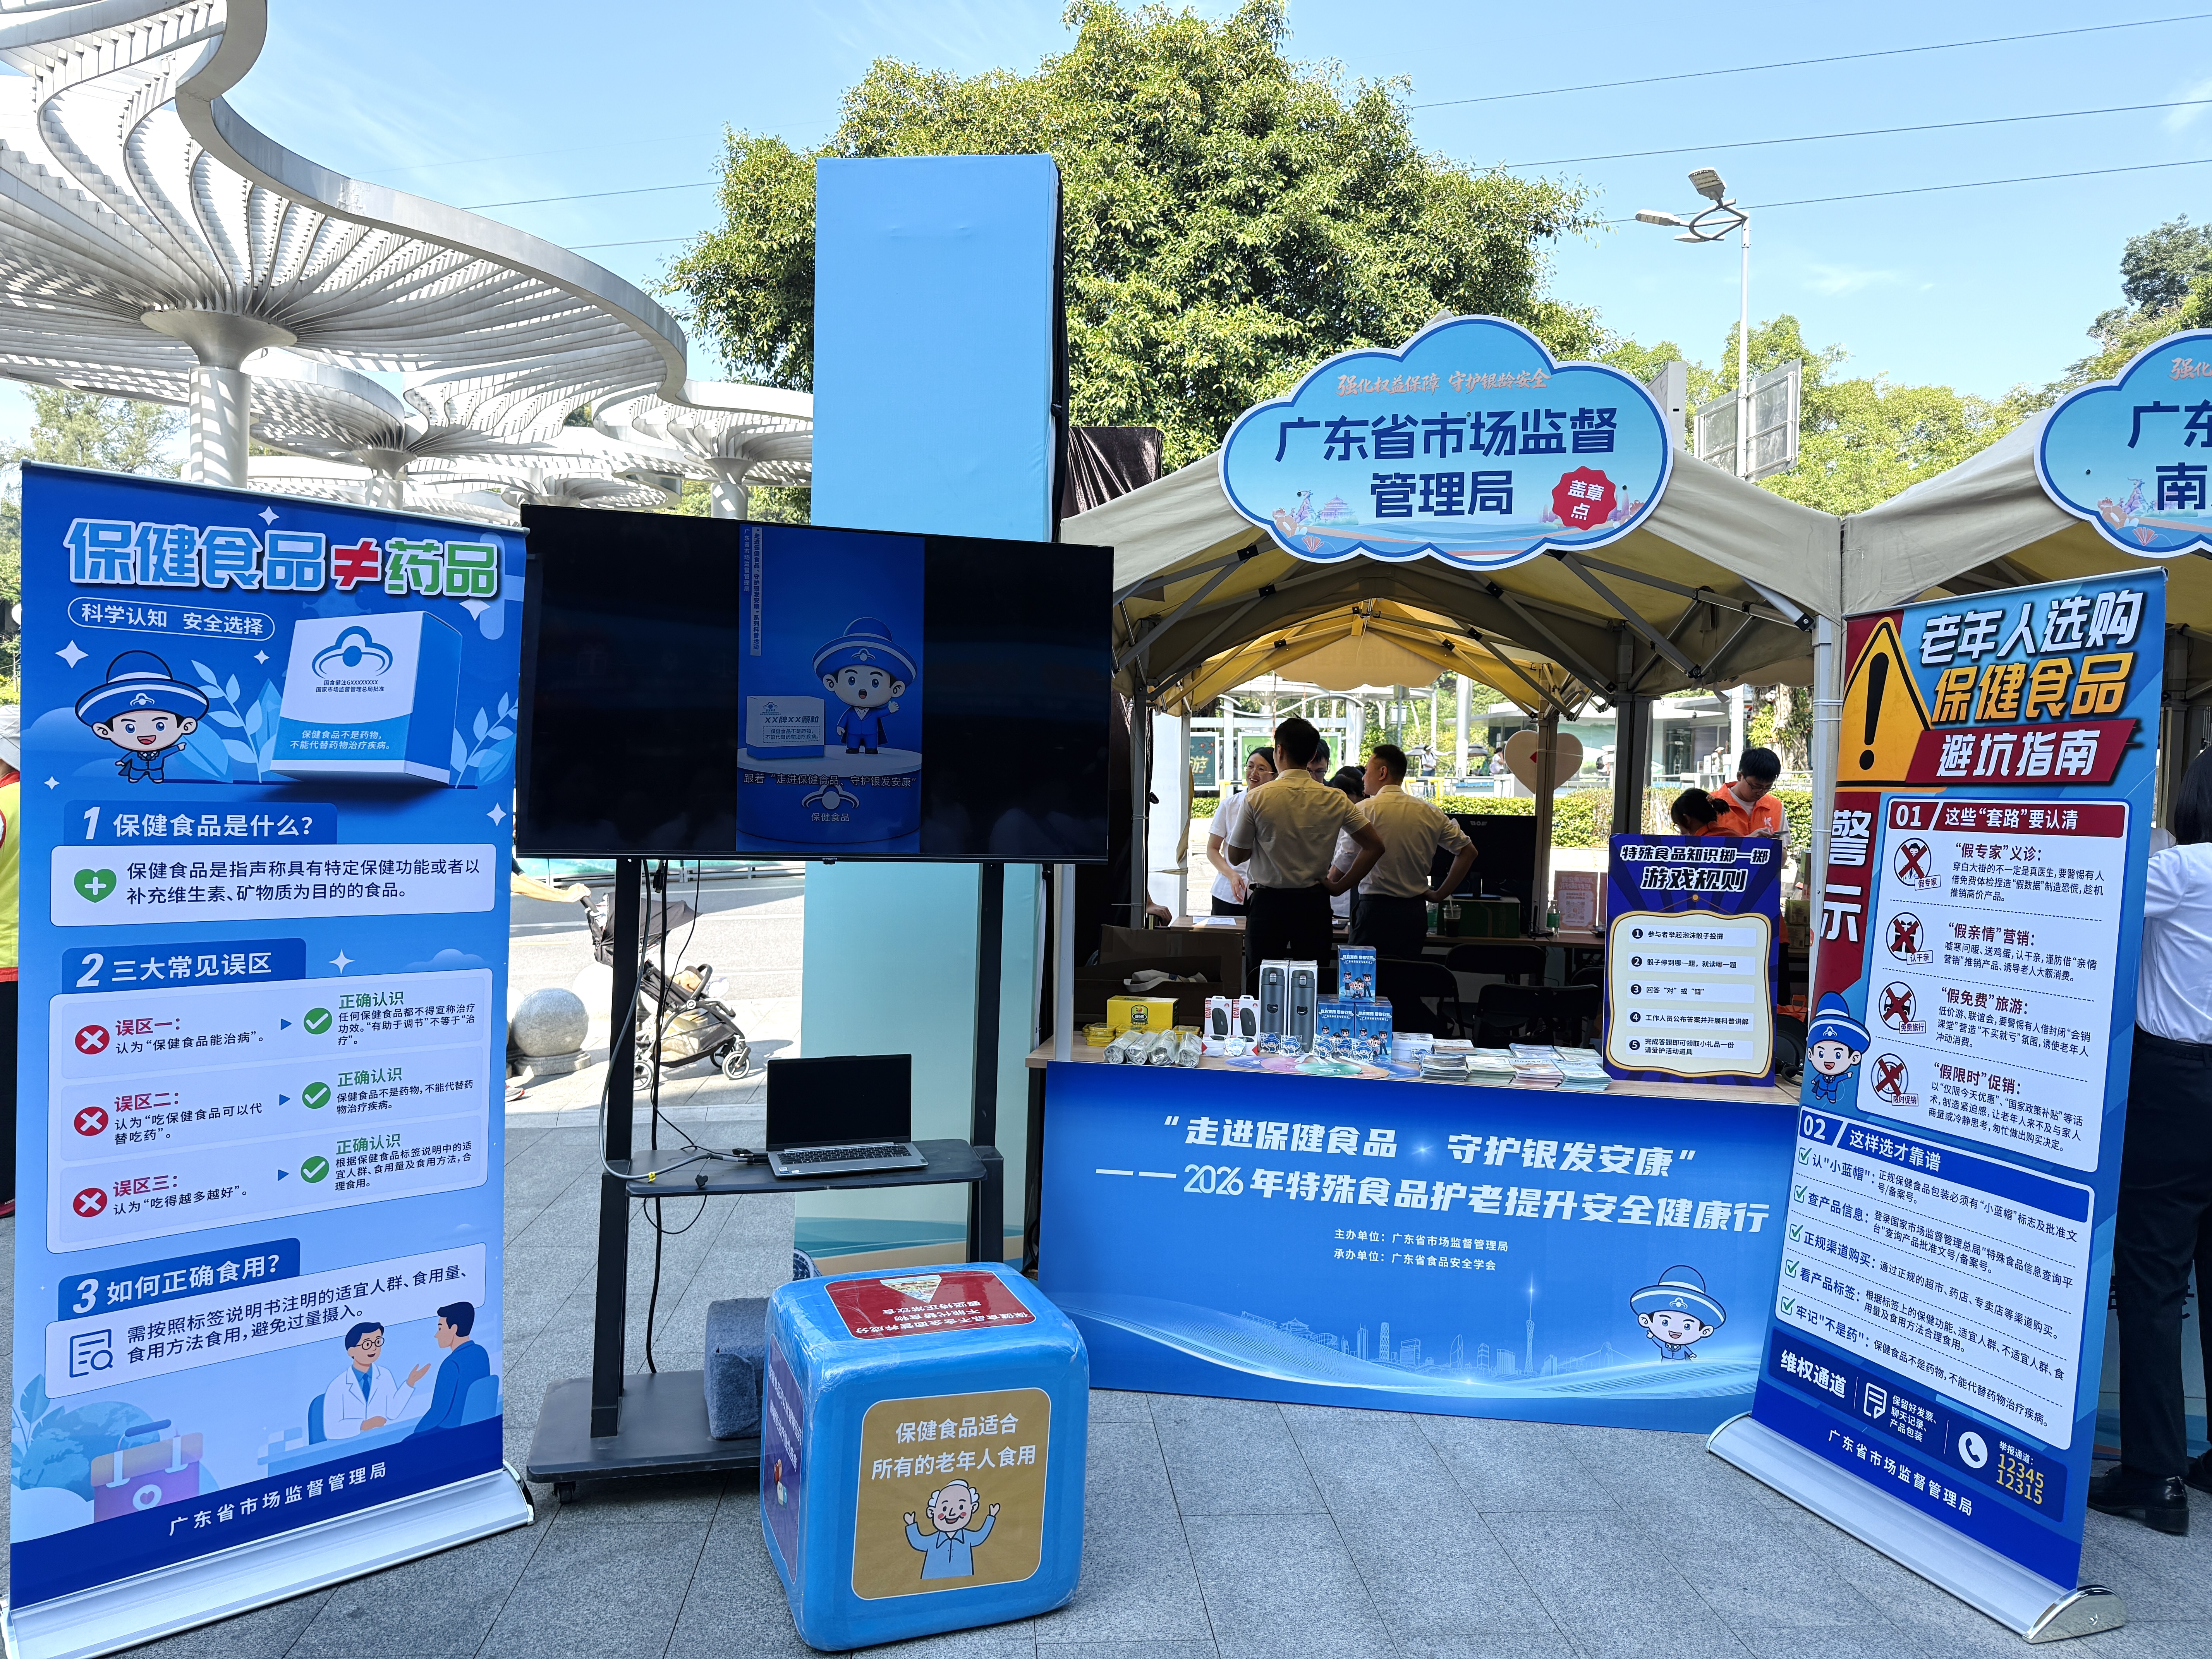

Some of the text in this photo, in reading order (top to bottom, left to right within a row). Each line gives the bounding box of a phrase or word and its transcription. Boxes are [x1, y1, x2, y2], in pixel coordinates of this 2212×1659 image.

[1335, 367, 1551, 397] 强化权益保障 守护银龄安全
[1275, 407, 1618, 461] 广东省市场监督
[1370, 471, 1513, 518] 管理局
[1568, 480, 1604, 501] 盖章
[1571, 503, 1588, 521] 点
[82, 603, 264, 635] 科学认知 安全选择
[1921, 590, 2143, 664] 老年人选购
[1931, 653, 2134, 722] 保健食品
[290, 741, 390, 750] 不能代替药物治疗疾病。
[302, 730, 381, 739] 保健食品不是药物，
[1937, 730, 2100, 776] 避坑指南
[83, 807, 313, 839] 1 保健食品是什么？
[811, 813, 850, 821] 保健食品
[1896, 805, 2078, 830] 01 这些“套路”要认清
[1621, 845, 1770, 864] 特殊食品知识掷一掷
[1956, 843, 2041, 862] “假专家”义诊：
[127, 859, 480, 880] 保健食品是指声称具有特定保健功能或者以
[1640, 867, 1749, 892] 游戏规则
[1820, 810, 1872, 942] 警示
[1953, 862, 2104, 881] 穿白大褂的不一定是真医生，要警惕有人
[127, 882, 407, 905] 补充维生素、矿物质为目的的食品。
[1918, 878, 1937, 888] 假专家
[1950, 888, 2004, 902] 推销高价产品。
[1952, 875, 2104, 896] 借免费体检捏造“假数据”制造恐慌，趁机
[1648, 931, 1724, 939] 参与者举起泡沫骰子投掷
[1949, 922, 2035, 946] “假亲情”营销：
[76, 952, 272, 987] 2 三大常见误区
[1647, 959, 1736, 968] 骰子停到哪一题，就读哪一题
[1910, 953, 1929, 962] 认干亲
[1944, 954, 2073, 982] 营销”推销产品、诱导老人大额消费。
[338, 1003, 475, 1022] 任何保健食品都不得宣称治疗
[339, 991, 404, 1009] 正确认识
[1941, 987, 2028, 1015] “假免费”旅游：
[116, 1018, 180, 1036] 误区一：
[338, 1014, 475, 1034] 功效。“有助于调节”不等于“治
[1645, 1015, 1749, 1025] 工作人员公布答案并开展科普讲解
[1901, 1023, 1924, 1032] 免费旅行
[1939, 1006, 2090, 1042] 低价游、联谊会，要警惕有人借封闭“会销
[116, 1031, 264, 1054] 认为“保健食品能治病”。
[1645, 1039, 1734, 1048] 完成答题即可领取小礼品一份
[1936, 1032, 1972, 1048] 冲动消费。
[337, 1067, 402, 1087] 正确认识
[1934, 1062, 2021, 1095] “假限时”促销：
[114, 1092, 179, 1113] 误区二：
[337, 1080, 473, 1103] 保健食品不是药物，不能代替药
[1893, 1096, 1917, 1105] 限时促销
[115, 1103, 263, 1130] 认为“吃保健食品可以代
[337, 1101, 392, 1115] 物治疗疾病。
[1930, 1095, 2081, 1141] 术，制造紧迫感，让老年人来不及与家人
[115, 1128, 171, 1145] 替吃药”。
[1929, 1108, 2063, 1152] 商量或冷静思考，匆忙做出购买决定。
[335, 1141, 472, 1168] 根据保健食品标签说明中的适
[336, 1133, 400, 1155] 正确认识
[1164, 1116, 1697, 1177] “走进保健食品 守护银发安康”
[1803, 1115, 1941, 1172] 02 这样选才靠谱
[335, 1152, 472, 1180] 宜人群、食用量及食用方法，合
[113, 1175, 178, 1197] 误区三：
[335, 1180, 370, 1191] 理食用。
[1878, 1183, 1918, 1204] 号/备案号。
[113, 1186, 247, 1215] 认为“吃得越多越好”。
[1808, 1193, 1869, 1223] 查产品信息：
[1804, 1231, 1875, 1269] 正规渠道购买：
[72, 1254, 280, 1314] 3 如何正确食用？
[1800, 1268, 1860, 1302] 看产品标签：
[127, 1265, 467, 1344] 需按照标签说明书注明的适宜人群、食用量、
[883, 1301, 982, 1315] 要坚持正常饮食
[1880, 1261, 2058, 1340] 通过正规的超市、药店、专卖店等渠道购买。
[856, 1312, 1029, 1334] 保健食品不含全面营养成分
[894, 1309, 981, 1321] 不能代替食物
[127, 1305, 363, 1365] 食用方法食用，避免过量摄入。
[1864, 1303, 1965, 1353] 用量及食用方法合理食用。
[1865, 1290, 2065, 1381] 根据标签上的保健功能、适宜人群、不适宜人群、食
[1781, 1350, 1847, 1398] 维权通道
[1874, 1340, 2048, 1428] 保健食品不是药物，不能代替药物治疗疾病。
[1891, 1407, 1927, 1432] 聊天记录、
[1893, 1395, 1936, 1424] 保留好发票、
[896, 1413, 1019, 1445] 保健食品适合
[1890, 1419, 1923, 1443] 产品包装
[871, 1445, 1036, 1480] 所有的老年人食用
[1999, 1441, 2034, 1465] 举报通道：
[1828, 1430, 1972, 1516] 广东省市场监督管理局
[1998, 1454, 2044, 1489] 12345
[168, 1461, 387, 1536] 广东省市场监督管理局
[1997, 1470, 2042, 1505] 12315
